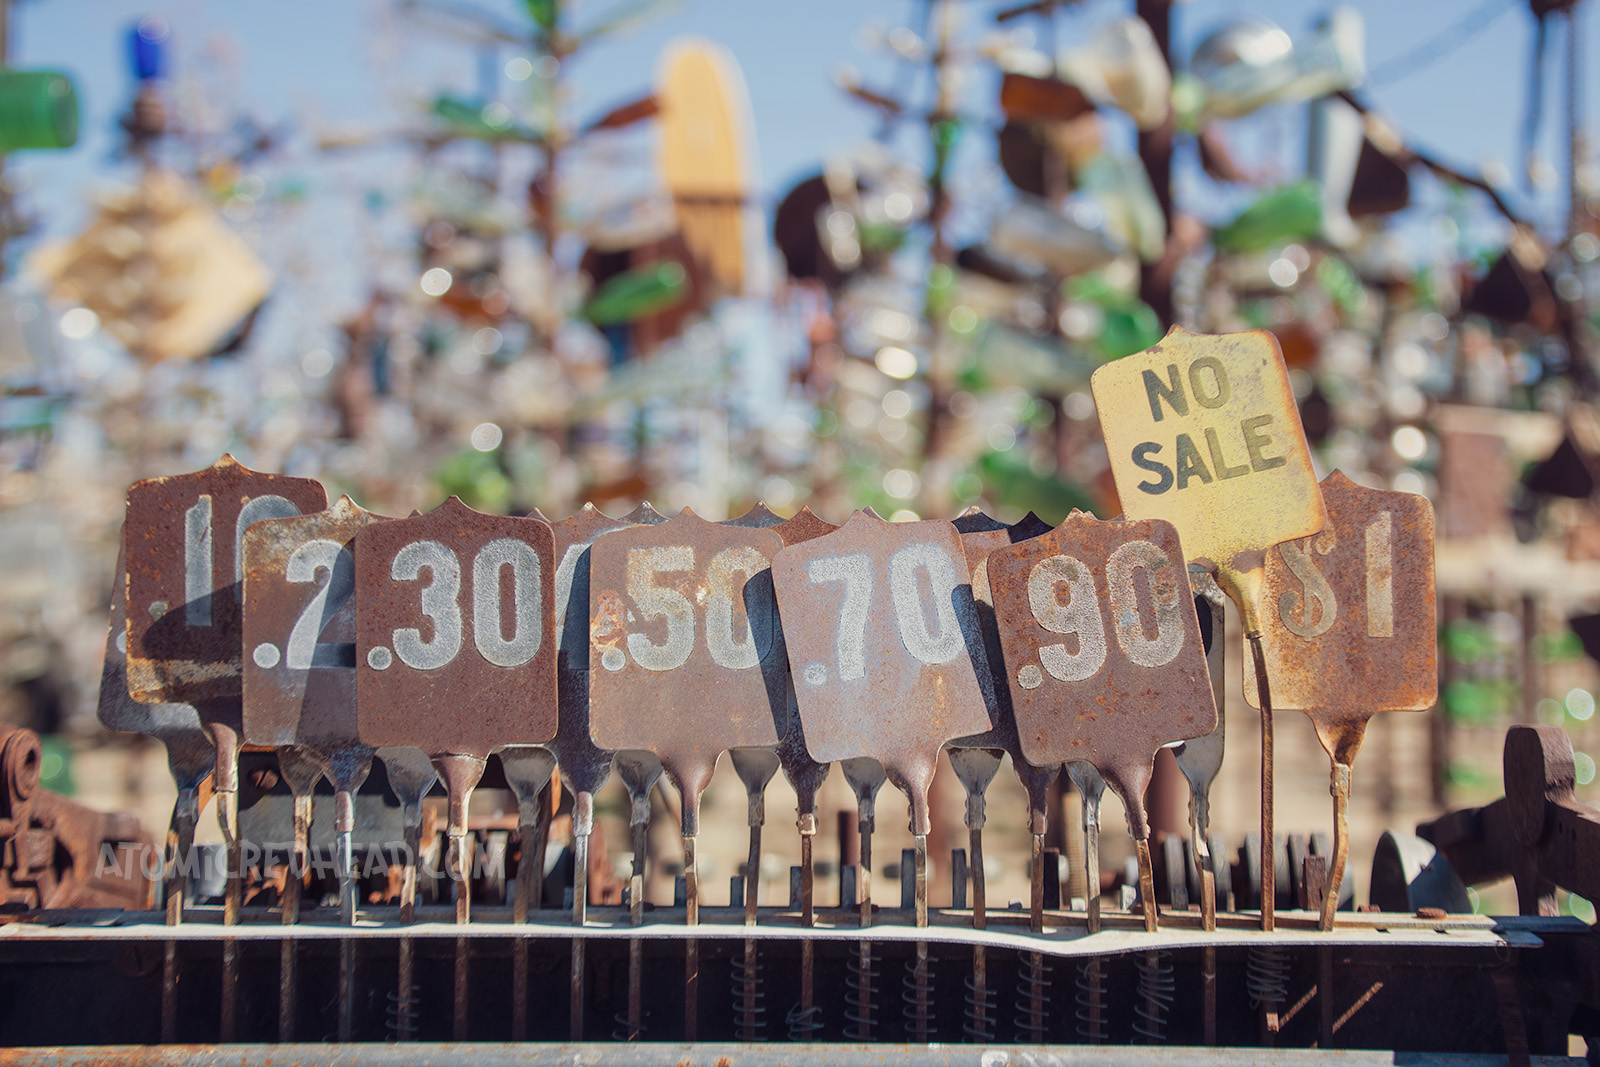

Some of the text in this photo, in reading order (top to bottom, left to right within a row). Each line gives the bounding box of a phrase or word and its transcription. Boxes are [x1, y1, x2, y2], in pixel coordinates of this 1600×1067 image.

[1141, 355, 1231, 422] NO
[1131, 414, 1286, 495] SALE
[367, 538, 542, 670] .30
[601, 545, 774, 672] .50
[804, 543, 968, 687] .70
[1017, 540, 1185, 690] .90
